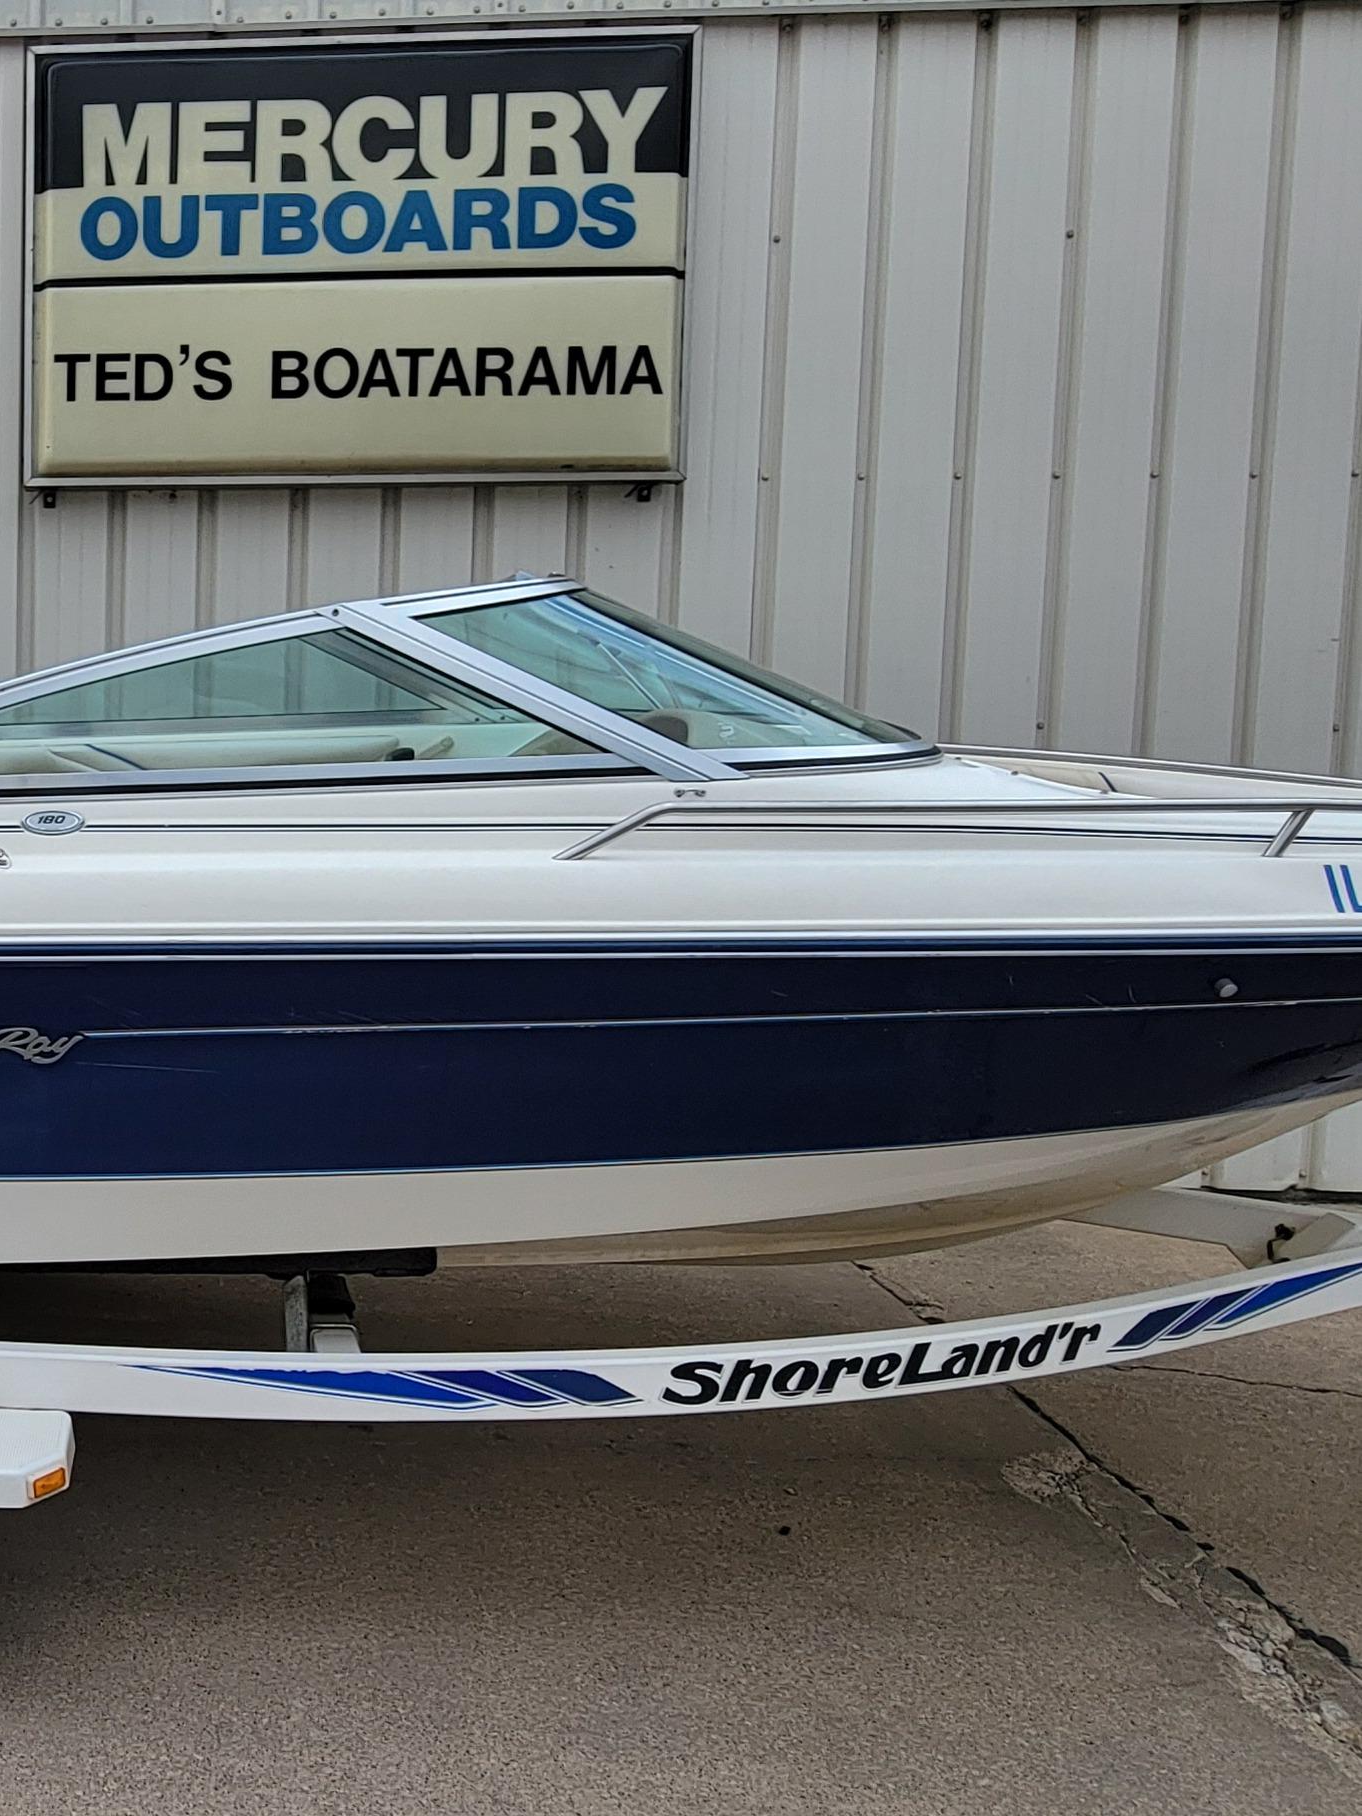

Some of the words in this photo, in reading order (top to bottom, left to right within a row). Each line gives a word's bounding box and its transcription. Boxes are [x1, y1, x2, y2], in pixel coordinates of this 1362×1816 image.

[82, 86, 668, 188] MERCURY
[79, 183, 636, 261] OUTBOARDS
[54, 345, 233, 402] TED'S
[270, 345, 663, 400] BOATARAMA
[37, 815, 66, 824] 180
[662, 1321, 1101, 1405] ShoreLand'r
